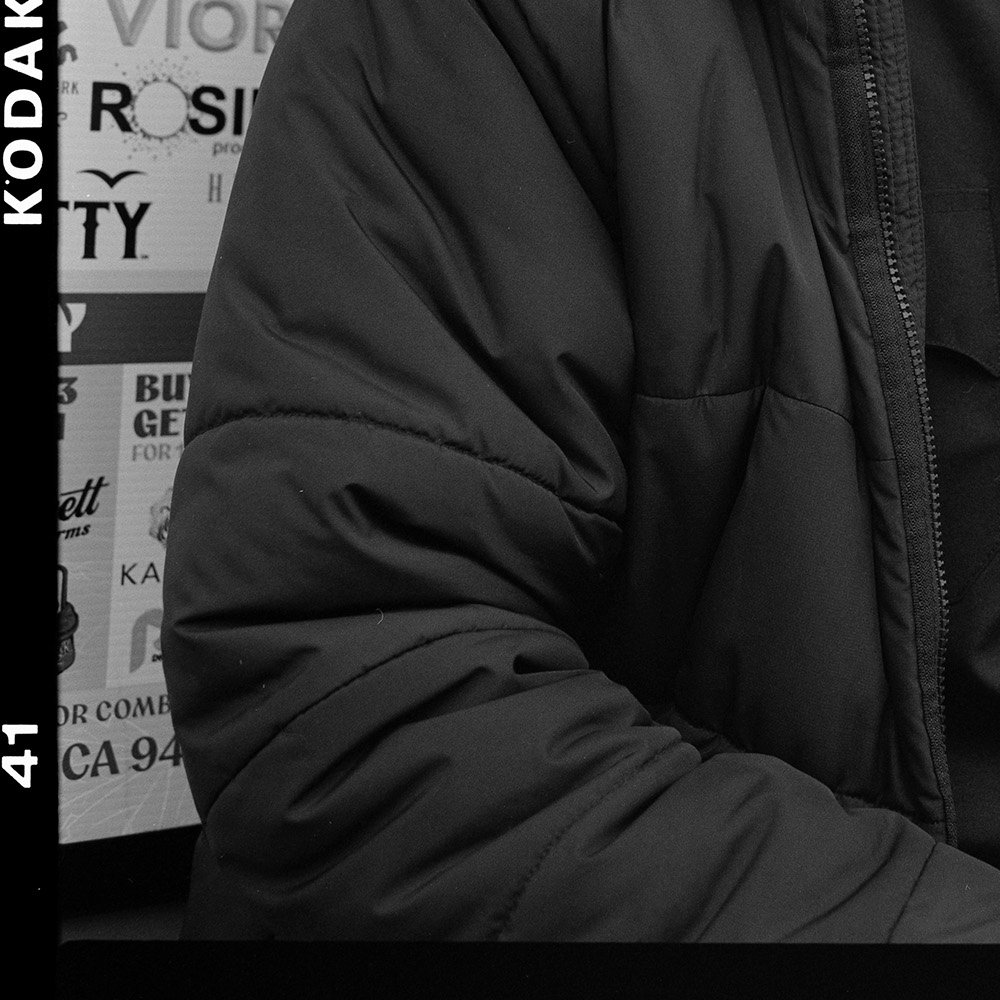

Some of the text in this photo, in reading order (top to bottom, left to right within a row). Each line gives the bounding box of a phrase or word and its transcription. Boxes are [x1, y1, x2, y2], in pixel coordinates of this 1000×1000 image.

[136, 373, 191, 403] BU
[133, 408, 186, 438] GE
[132, 443, 171, 462] FOR
[120, 561, 160, 587] KA
[62, 736, 183, 781] CA 94
